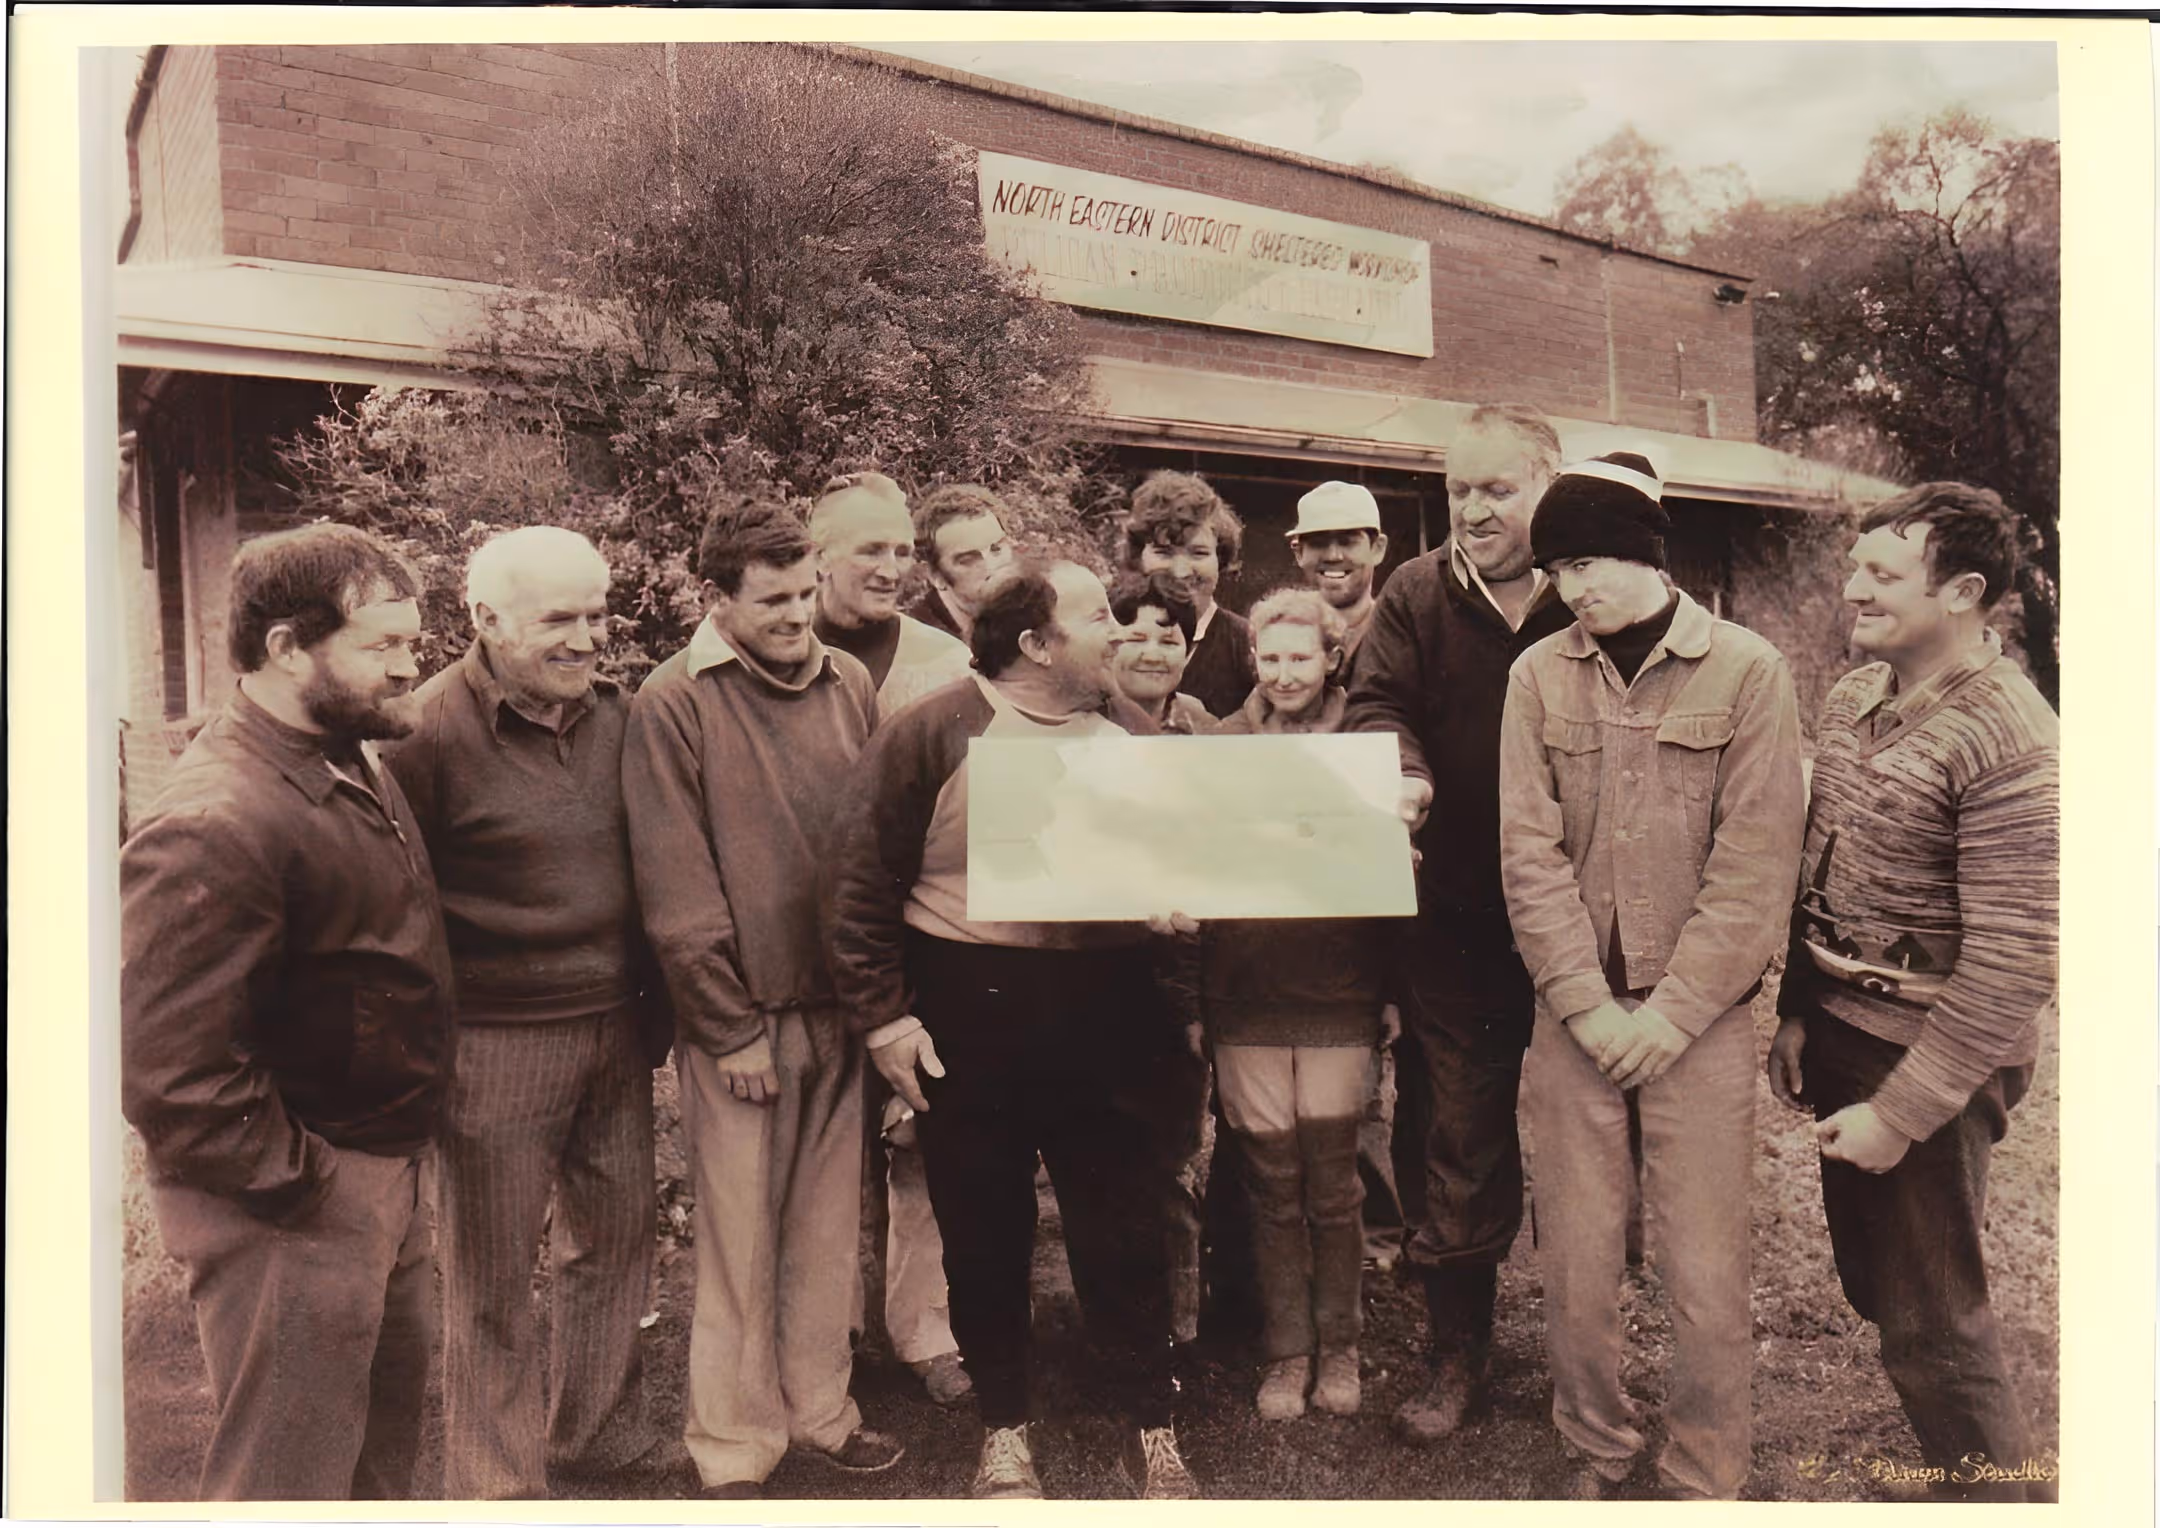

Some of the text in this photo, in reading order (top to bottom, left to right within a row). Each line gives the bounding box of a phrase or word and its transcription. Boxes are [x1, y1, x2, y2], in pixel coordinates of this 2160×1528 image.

[993, 180, 1066, 221] NORTH
[1069, 195, 1156, 238] EASTERN
[1161, 211, 1242, 254] DISTRICT
